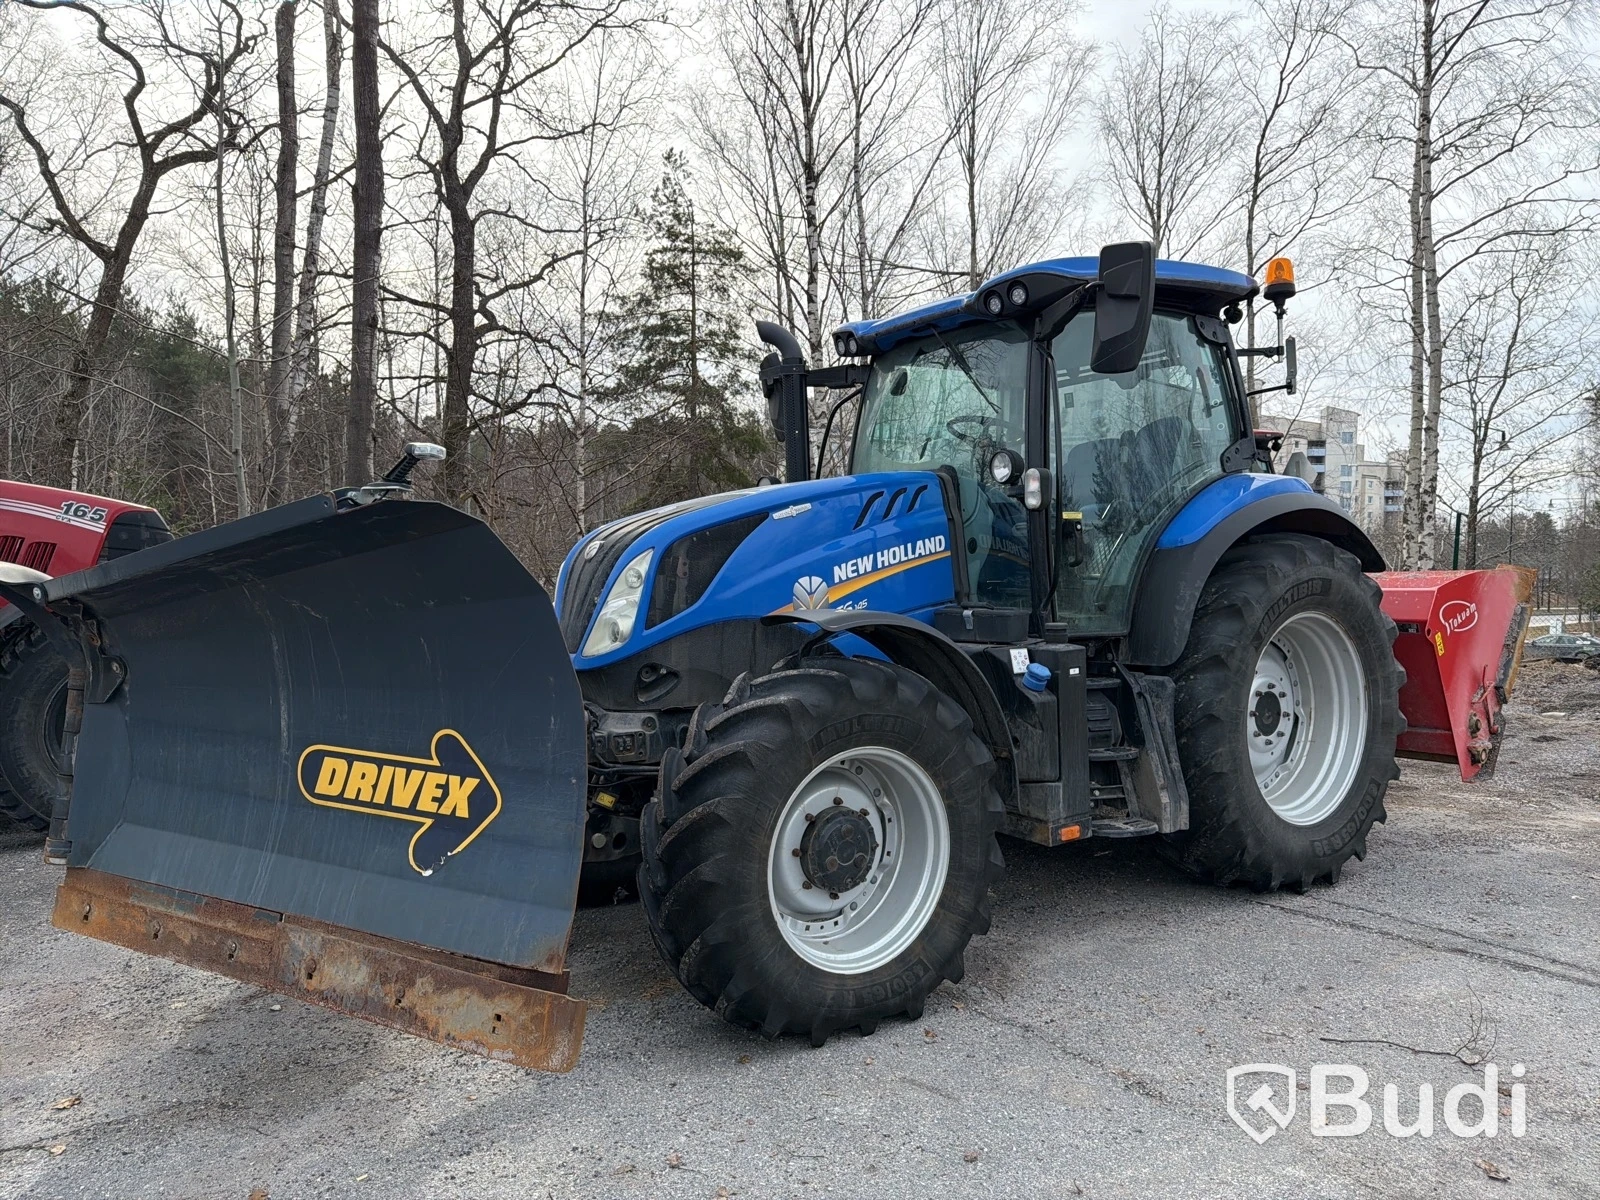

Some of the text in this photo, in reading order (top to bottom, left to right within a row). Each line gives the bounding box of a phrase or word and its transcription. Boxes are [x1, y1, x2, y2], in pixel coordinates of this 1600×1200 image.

[56, 514, 72, 523] CVX
[61, 500, 108, 522] 165
[833, 535, 946, 583] NEW HOLLAND
[314, 756, 481, 819] DRIVEX
